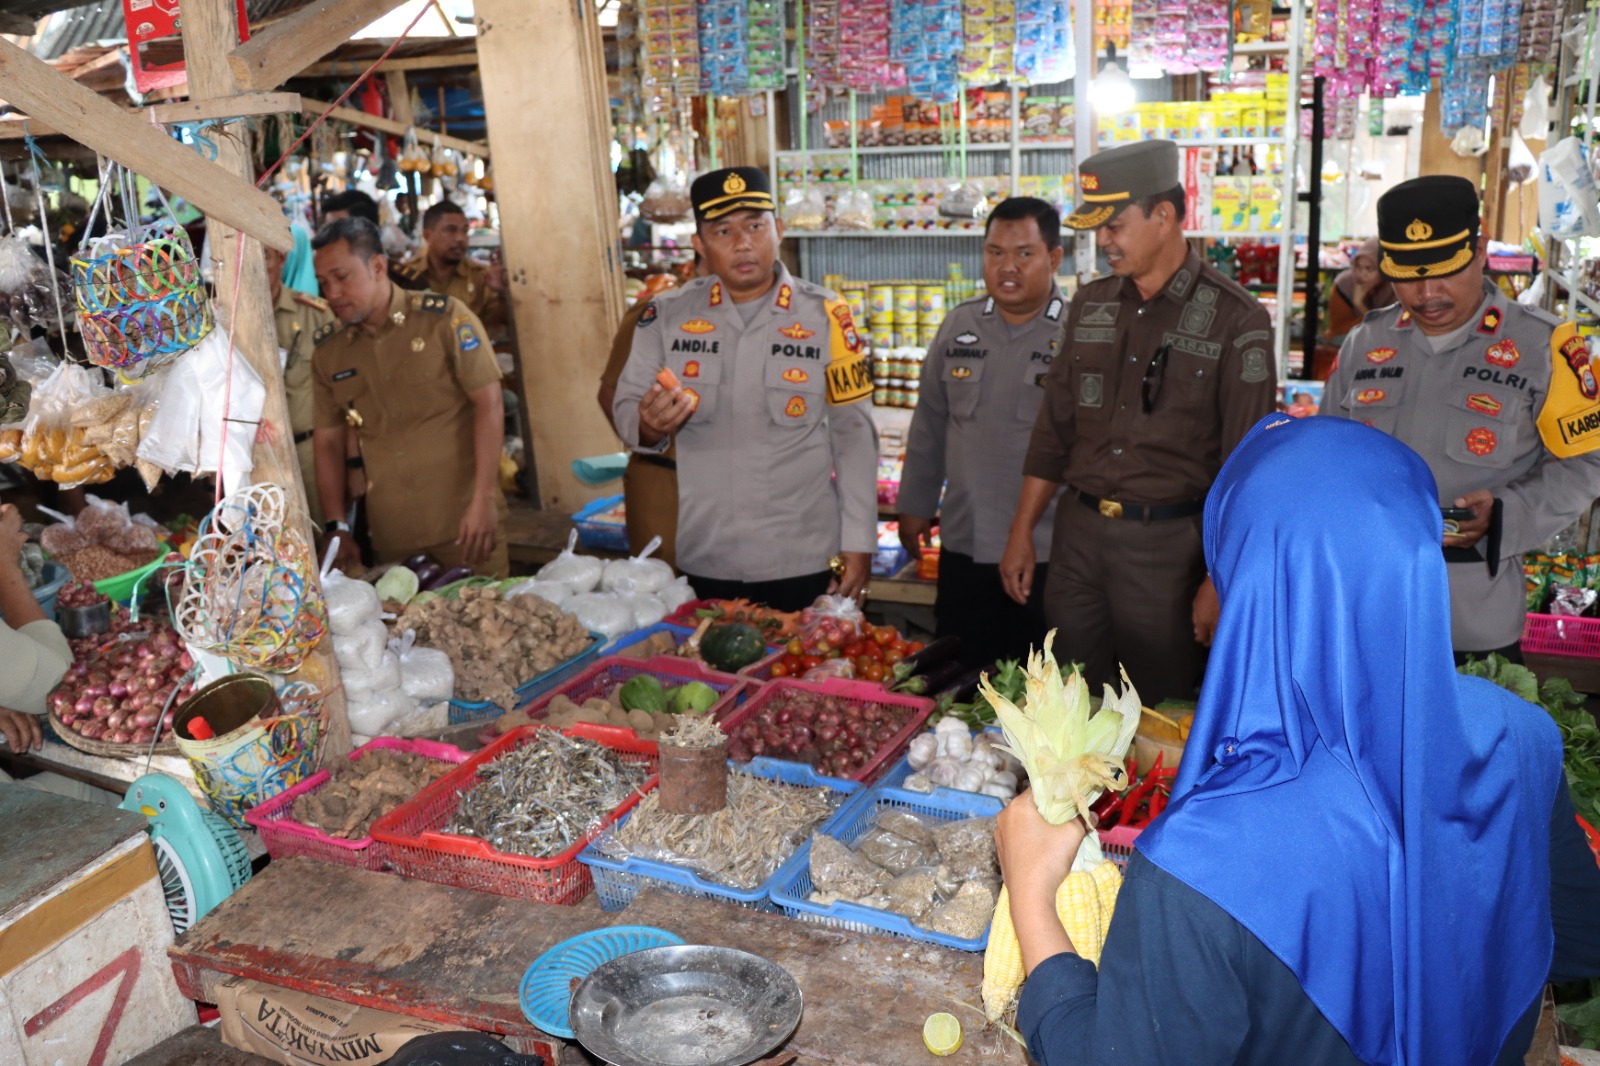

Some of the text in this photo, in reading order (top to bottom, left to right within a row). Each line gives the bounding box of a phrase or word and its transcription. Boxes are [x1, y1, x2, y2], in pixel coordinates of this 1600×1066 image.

[671, 338, 720, 354] ANDI.E
[771, 343, 821, 360] POLRI
[1165, 335, 1218, 355] KASAT
[830, 365, 853, 394] KA
[1463, 366, 1528, 390] POLRI
